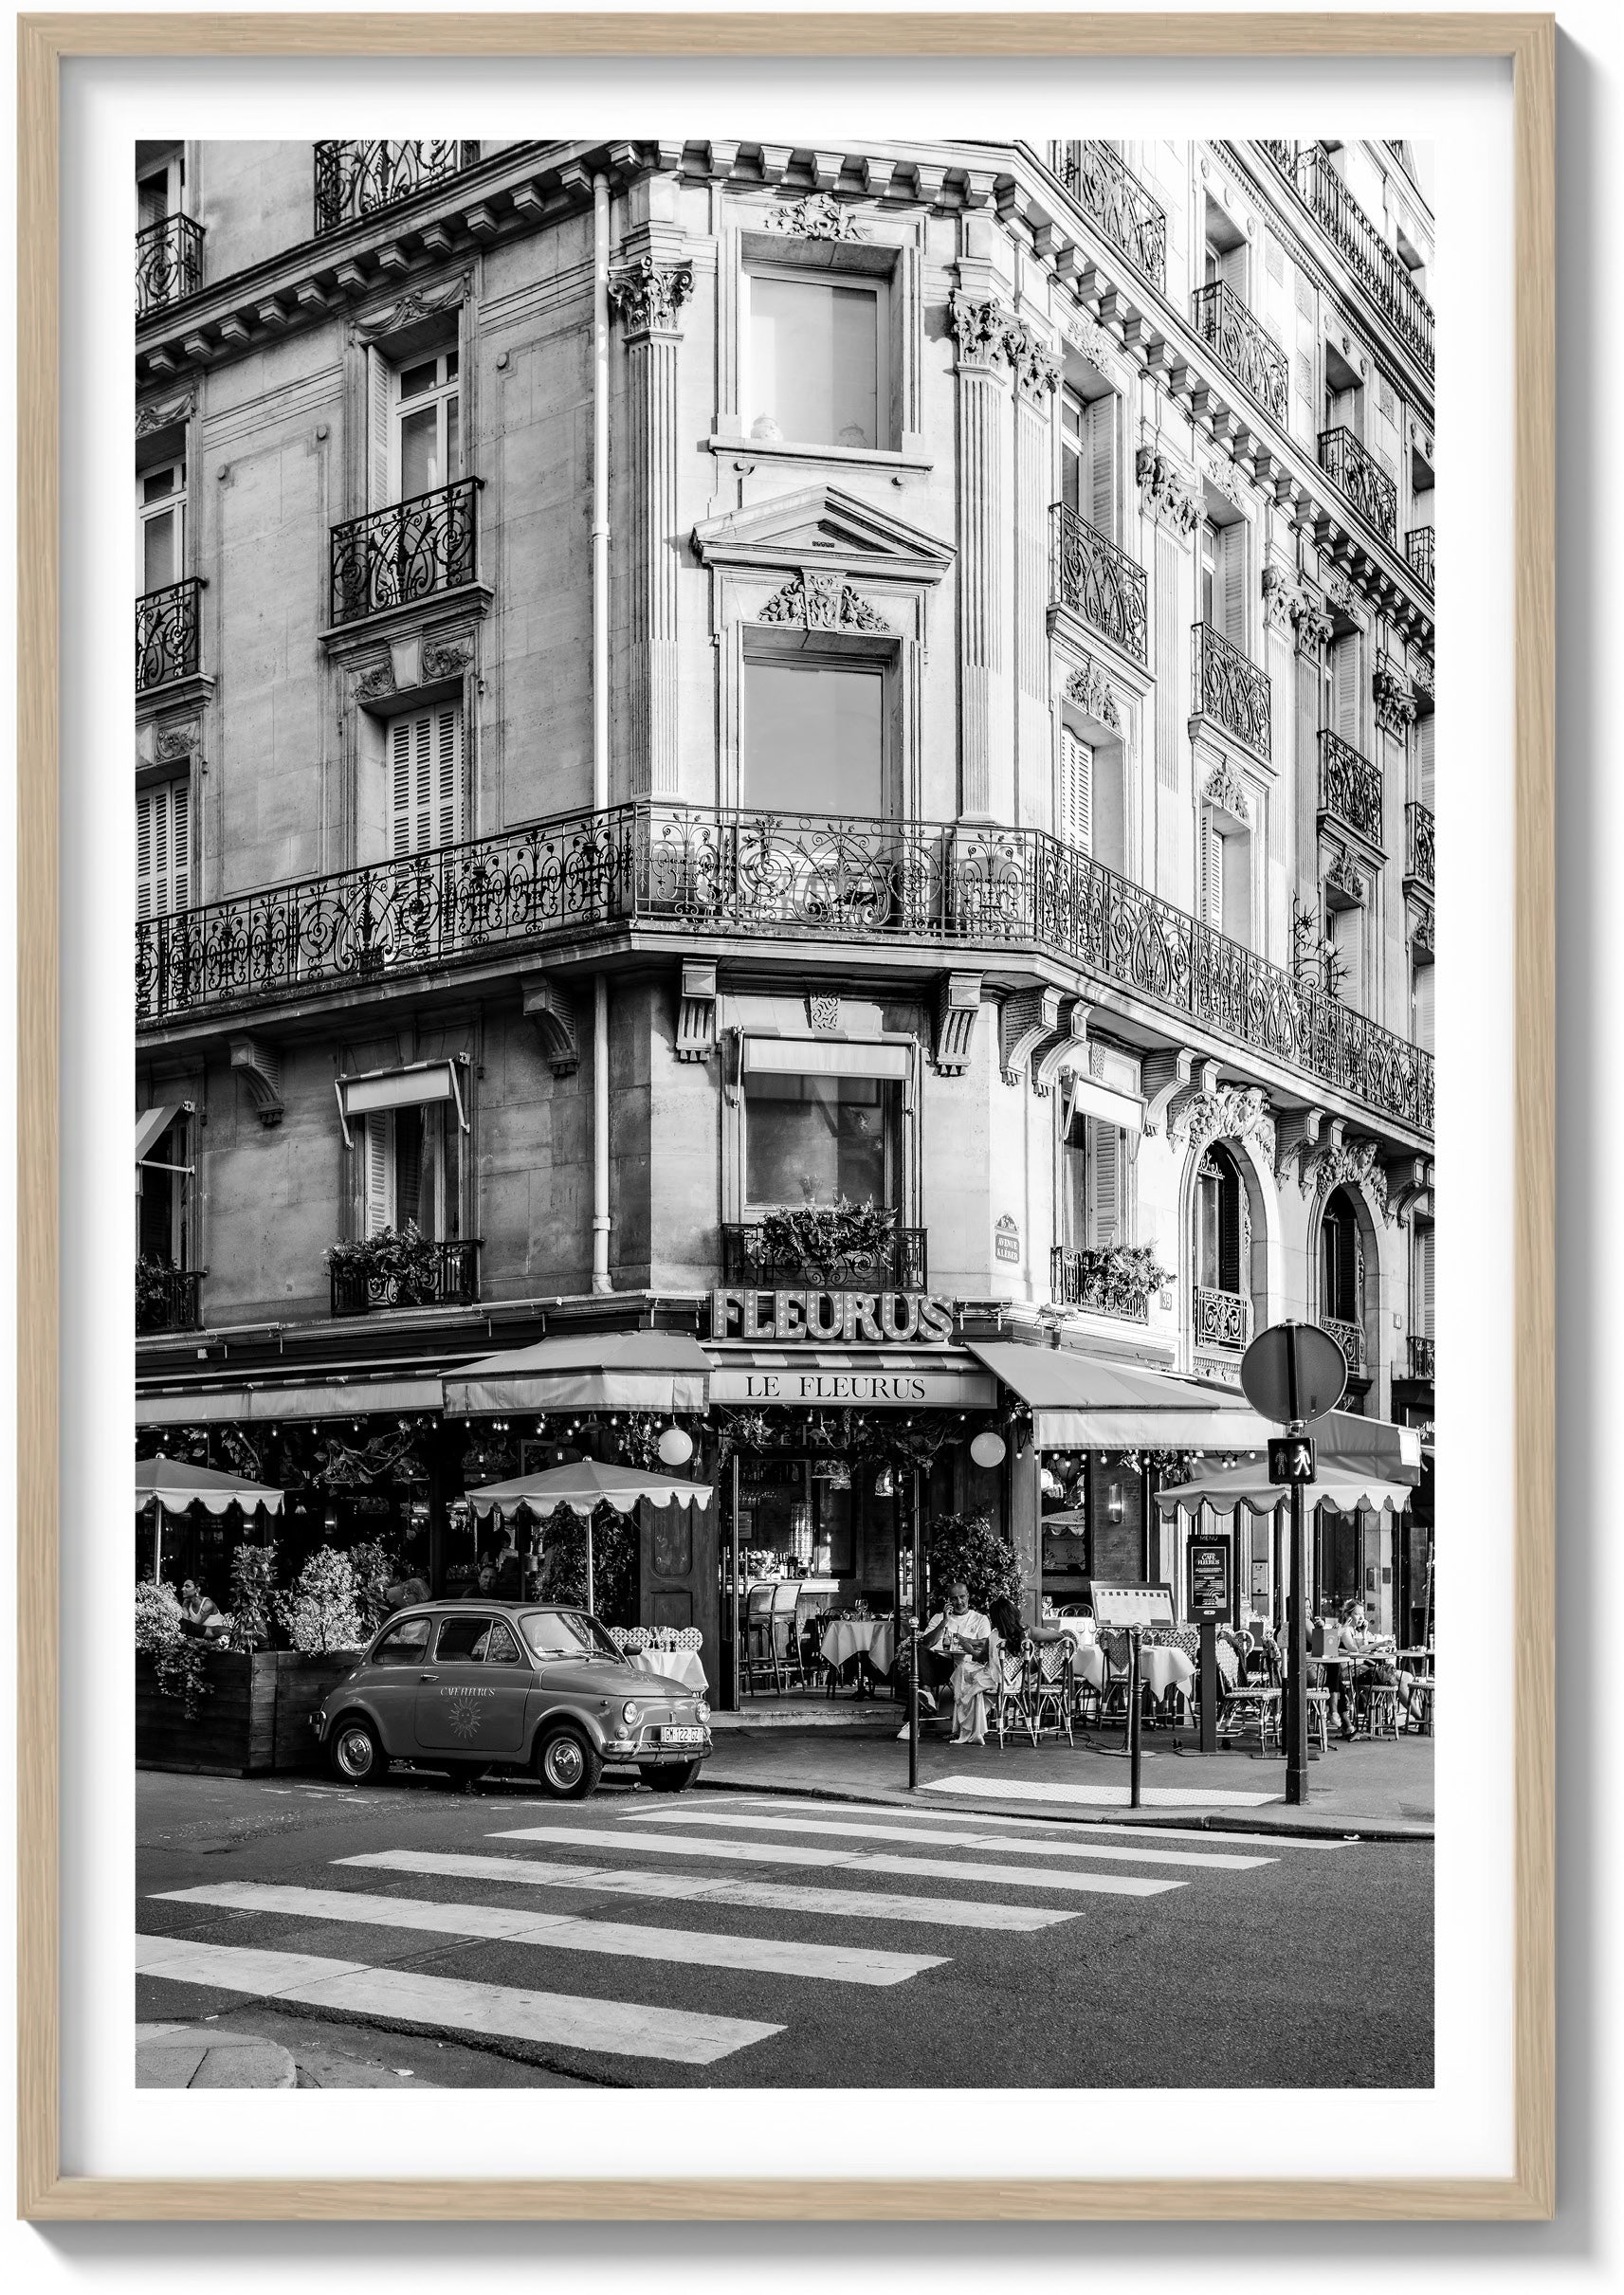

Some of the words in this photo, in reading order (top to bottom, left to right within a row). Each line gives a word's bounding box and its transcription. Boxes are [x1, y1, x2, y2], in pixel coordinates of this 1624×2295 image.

[997, 1237, 1018, 1250] AVENUE
[1162, 1292, 1172, 1309] 39
[711, 1288, 954, 1341] FLEURUS
[745, 1375, 780, 1398] LE
[799, 1376, 925, 1400] FLEURUS
